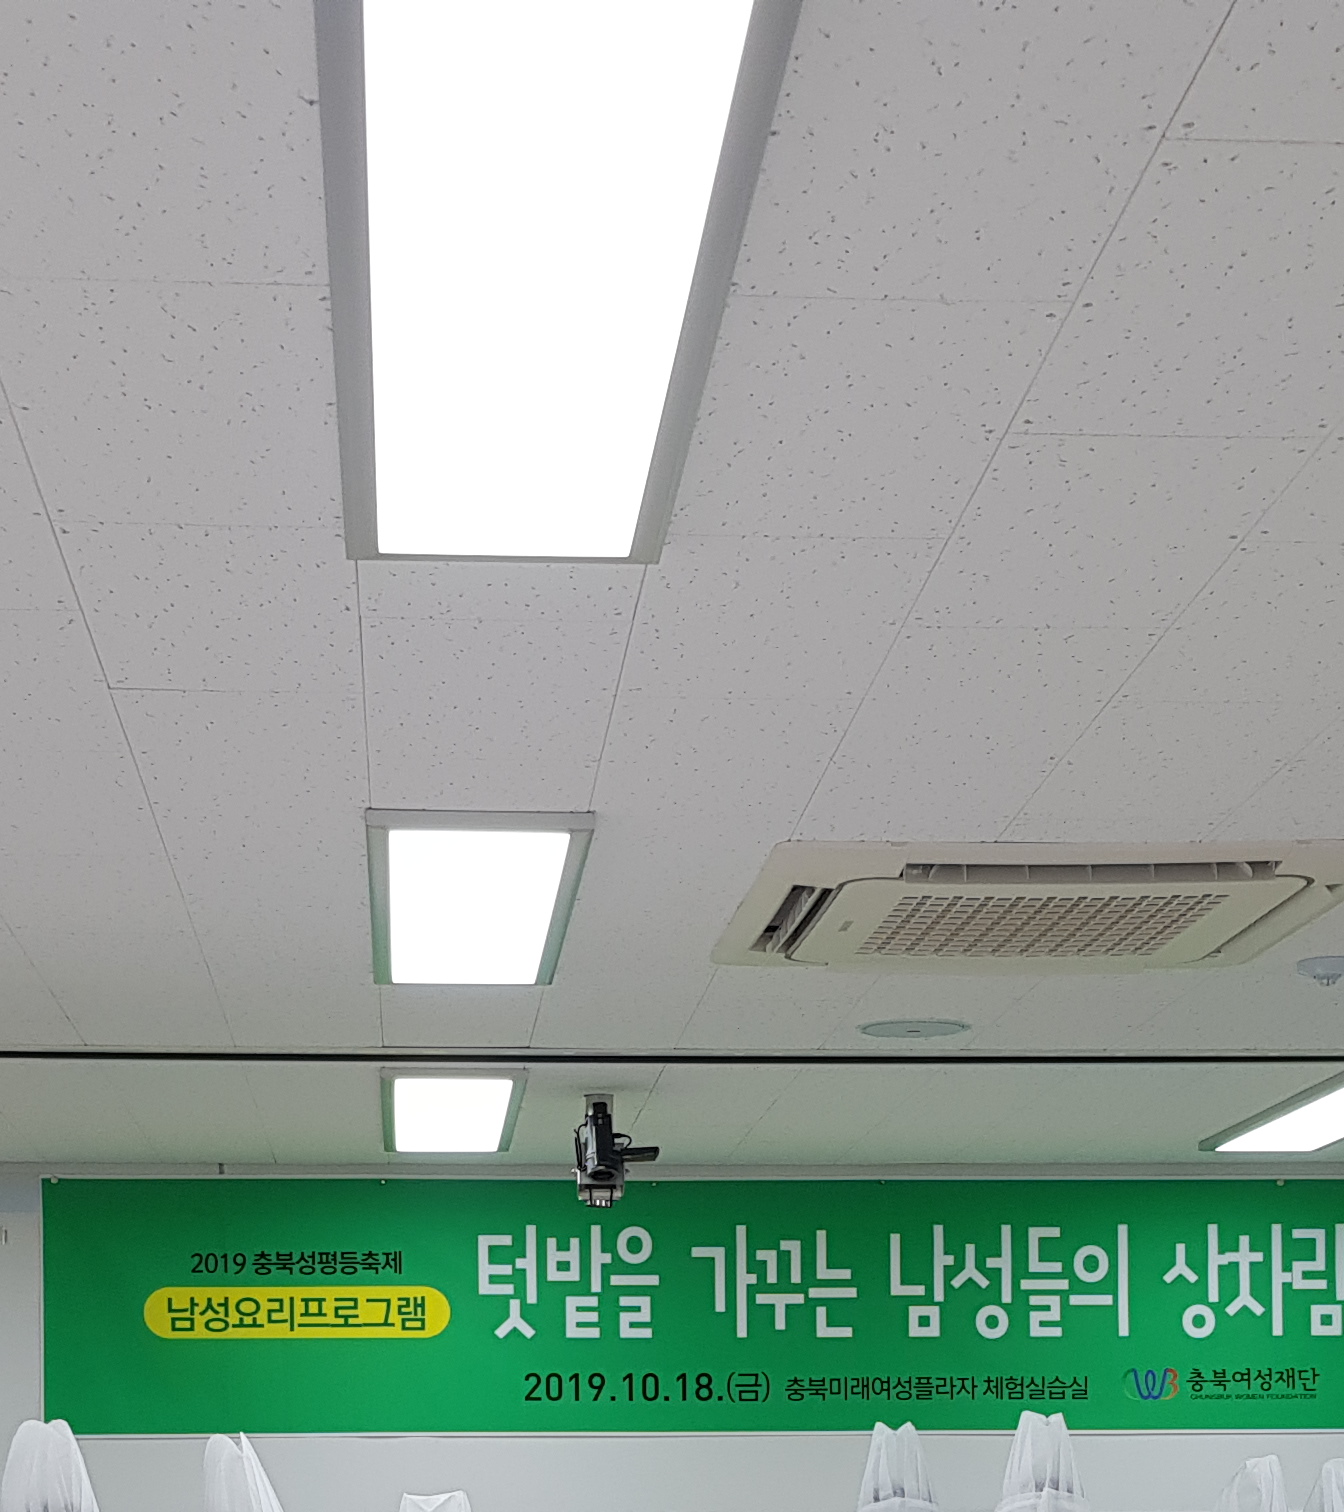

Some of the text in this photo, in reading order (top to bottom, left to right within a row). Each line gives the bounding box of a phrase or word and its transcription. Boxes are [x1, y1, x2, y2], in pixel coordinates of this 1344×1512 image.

[190, 1250, 403, 1277] 2019 충북성평등축제
[477, 1224, 661, 1340] 텃밭을
[691, 1223, 858, 1339] 가꾸는
[888, 1223, 1130, 1338] 남성들의
[165, 1295, 428, 1333] 남성요리프로그램
[784, 1375, 980, 1402] 충북미래여성플라자
[981, 1374, 1089, 1401] 체험실습실
[1185, 1367, 1320, 1393] 충북여성재단
